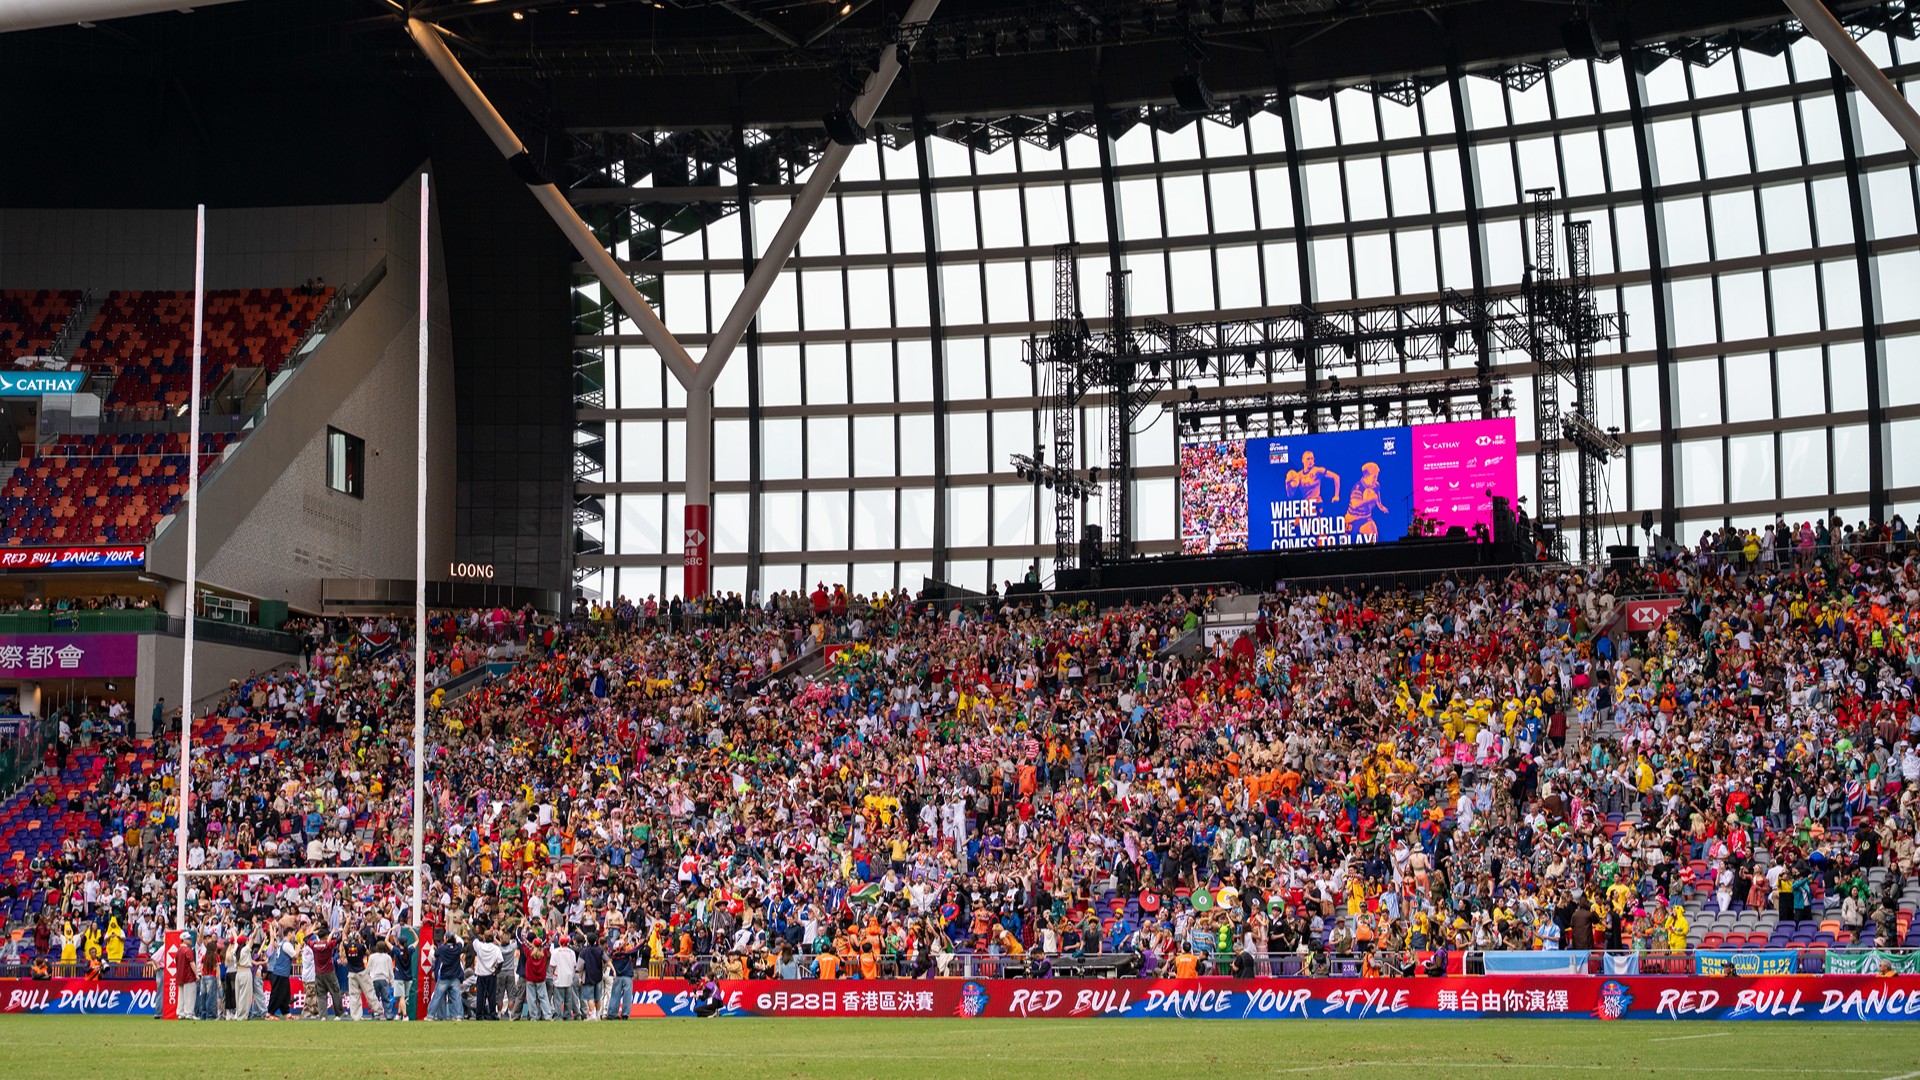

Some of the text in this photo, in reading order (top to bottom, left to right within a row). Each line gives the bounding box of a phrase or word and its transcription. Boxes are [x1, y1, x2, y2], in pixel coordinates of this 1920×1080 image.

[17, 379, 76, 391] CATHAY
[1432, 441, 1460, 450] CATHAY
[1271, 499, 1317, 519] WHERE
[1271, 516, 1345, 538] THE WORLD
[3, 552, 27, 566] RED
[30, 552, 57, 565] BULL
[62, 549, 101, 565] DANCE
[104, 551, 134, 565] YOUR
[450, 562, 494, 579] LOONG
[0, 644, 84, 669] 際都會
[1342, 964, 1355, 972] 238
[4, 983, 157, 1014] BULL DANCE YOU
[757, 991, 934, 1011] 6月28日 香港區決賽
[1009, 989, 1063, 1017] RED
[1068, 988, 1132, 1016] BULL
[1144, 983, 1232, 1019] DANCE
[1242, 988, 1311, 1019] YOUR
[1322, 988, 1409, 1019] STYLE
[1437, 989, 1569, 1012] 舞台由你演繹
[1656, 981, 1920, 1021] RED BULL DANCE
